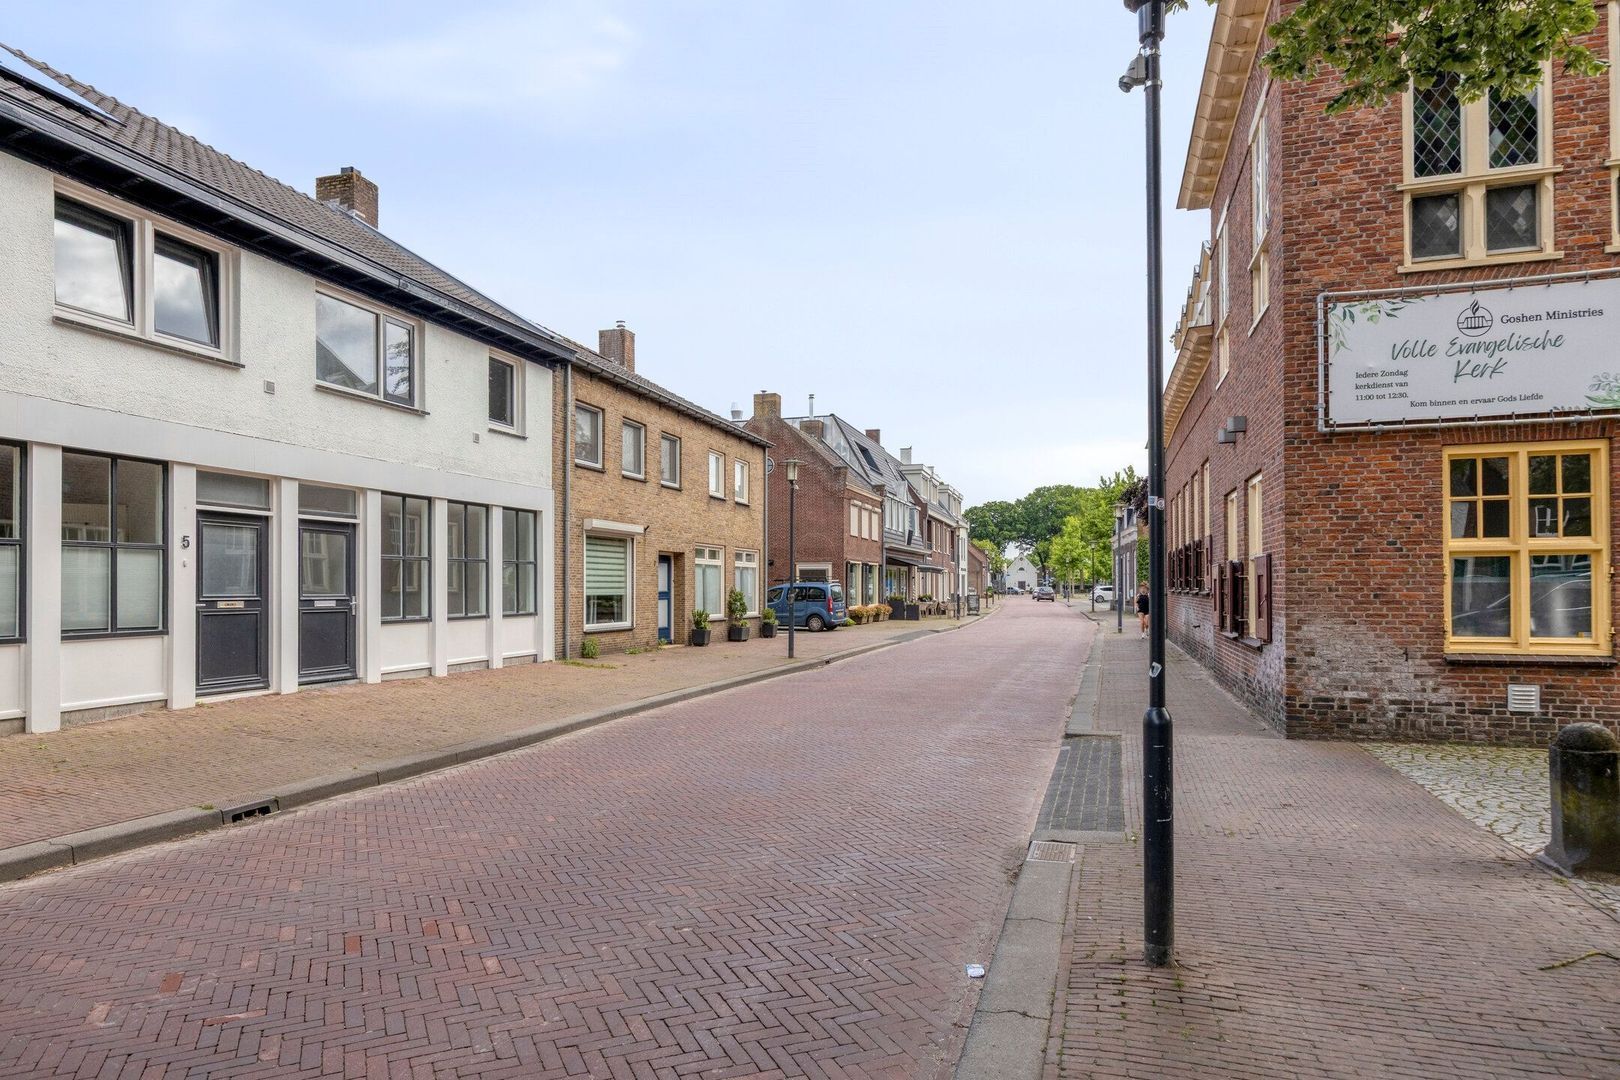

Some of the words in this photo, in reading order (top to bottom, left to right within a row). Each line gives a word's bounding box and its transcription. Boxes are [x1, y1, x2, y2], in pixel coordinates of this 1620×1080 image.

[1500, 313, 1542, 324] Goshen
[1546, 308, 1604, 320] Ministries
[1391, 339, 1438, 360] Volle
[1445, 330, 1566, 358] Evangelische
[1355, 371, 1379, 379] Iedere
[1380, 369, 1409, 378] Zondag
[1453, 358, 1507, 384] Kerk
[1355, 382, 1393, 390] kerkdienst
[1355, 393, 1375, 401] 11:00
[1388, 392, 1409, 400] 12:30.
[1410, 400, 1428, 408] Kom
[1429, 398, 1457, 407] binnen
[1470, 397, 1496, 405] ervaar
[1497, 395, 1517, 403] Gods
[1519, 393, 1544, 402] Liefde
[182, 535, 190, 549] 5
